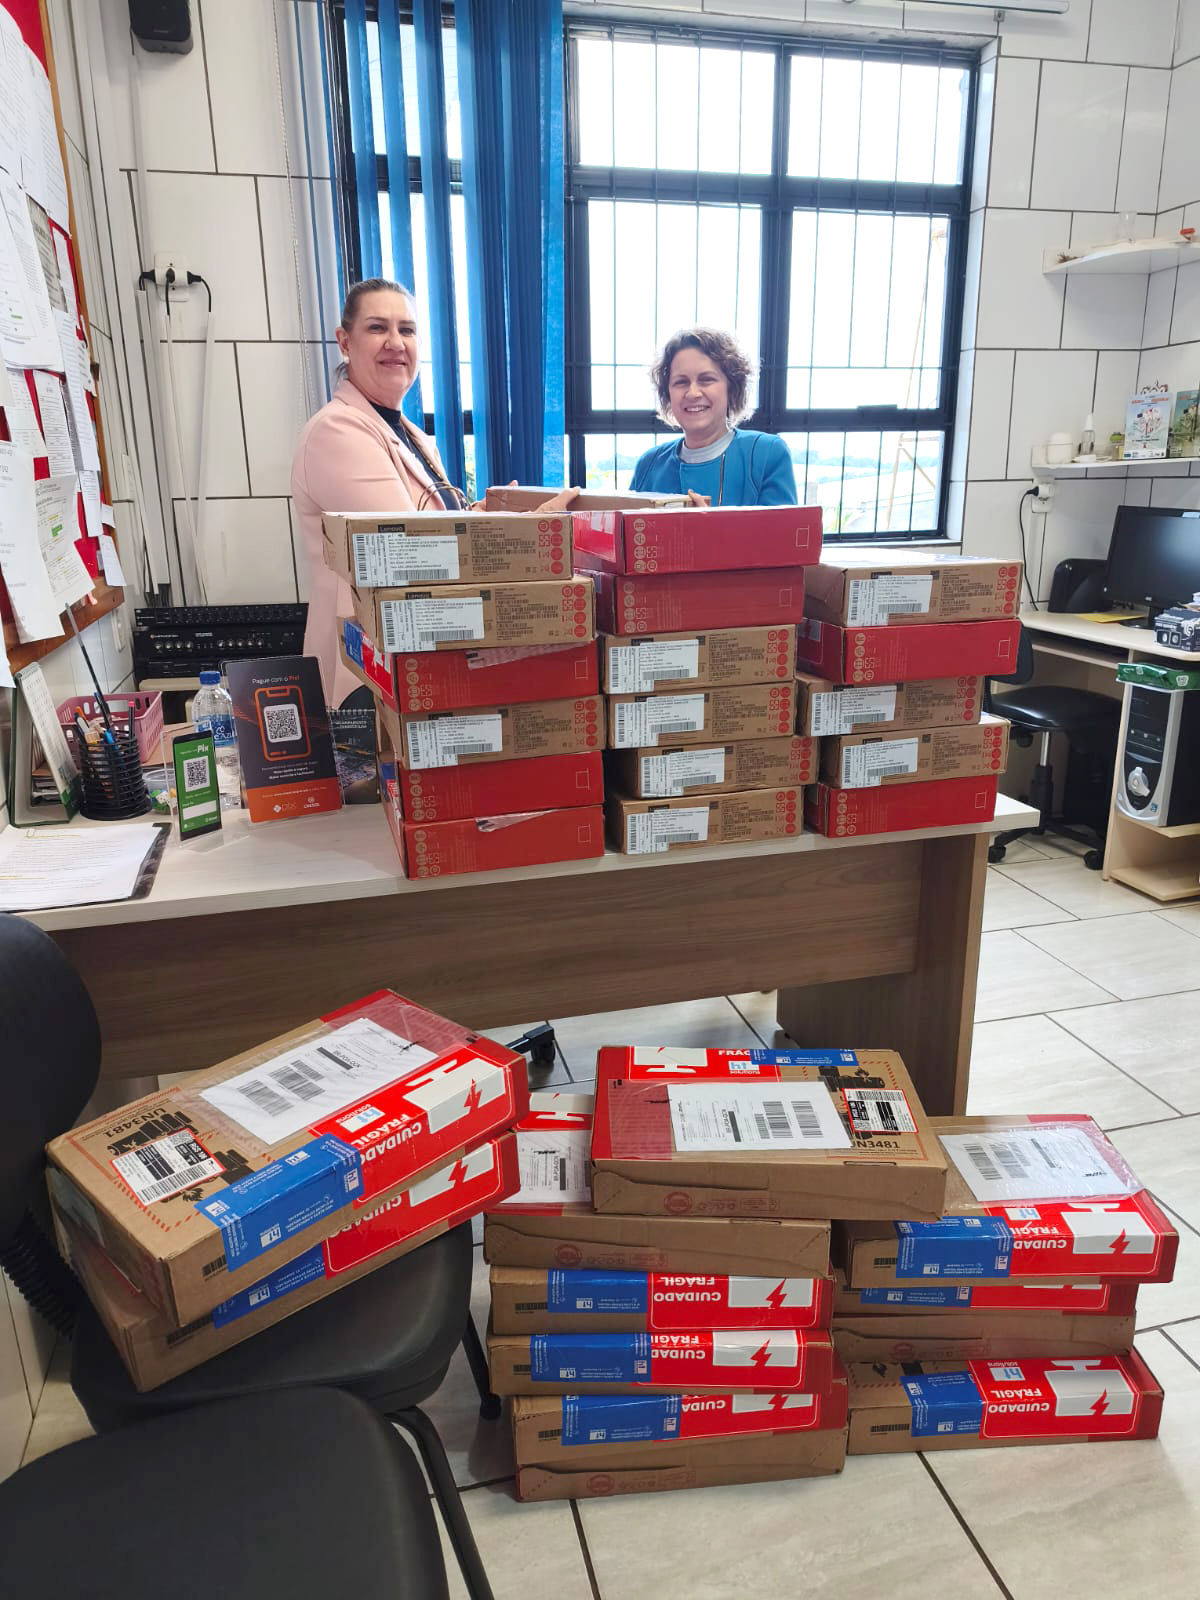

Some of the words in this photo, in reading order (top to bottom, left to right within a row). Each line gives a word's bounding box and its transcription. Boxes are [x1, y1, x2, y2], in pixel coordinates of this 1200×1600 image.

[336, 1103, 372, 1123] solutions
[103, 1106, 166, 1140] UN3481
[351, 1113, 411, 1146] FRÁGIL
[1013, 1238, 1067, 1249] CUIDAD
[660, 1277, 715, 1287] FRÁGIL
[654, 1291, 722, 1302] CUIDADO
[651, 1349, 706, 1360] CUIDAD
[990, 1388, 1042, 1399] FRÁGIL
[682, 1400, 726, 1412] CUIDA
[988, 1402, 1050, 1414] CUIDADO
